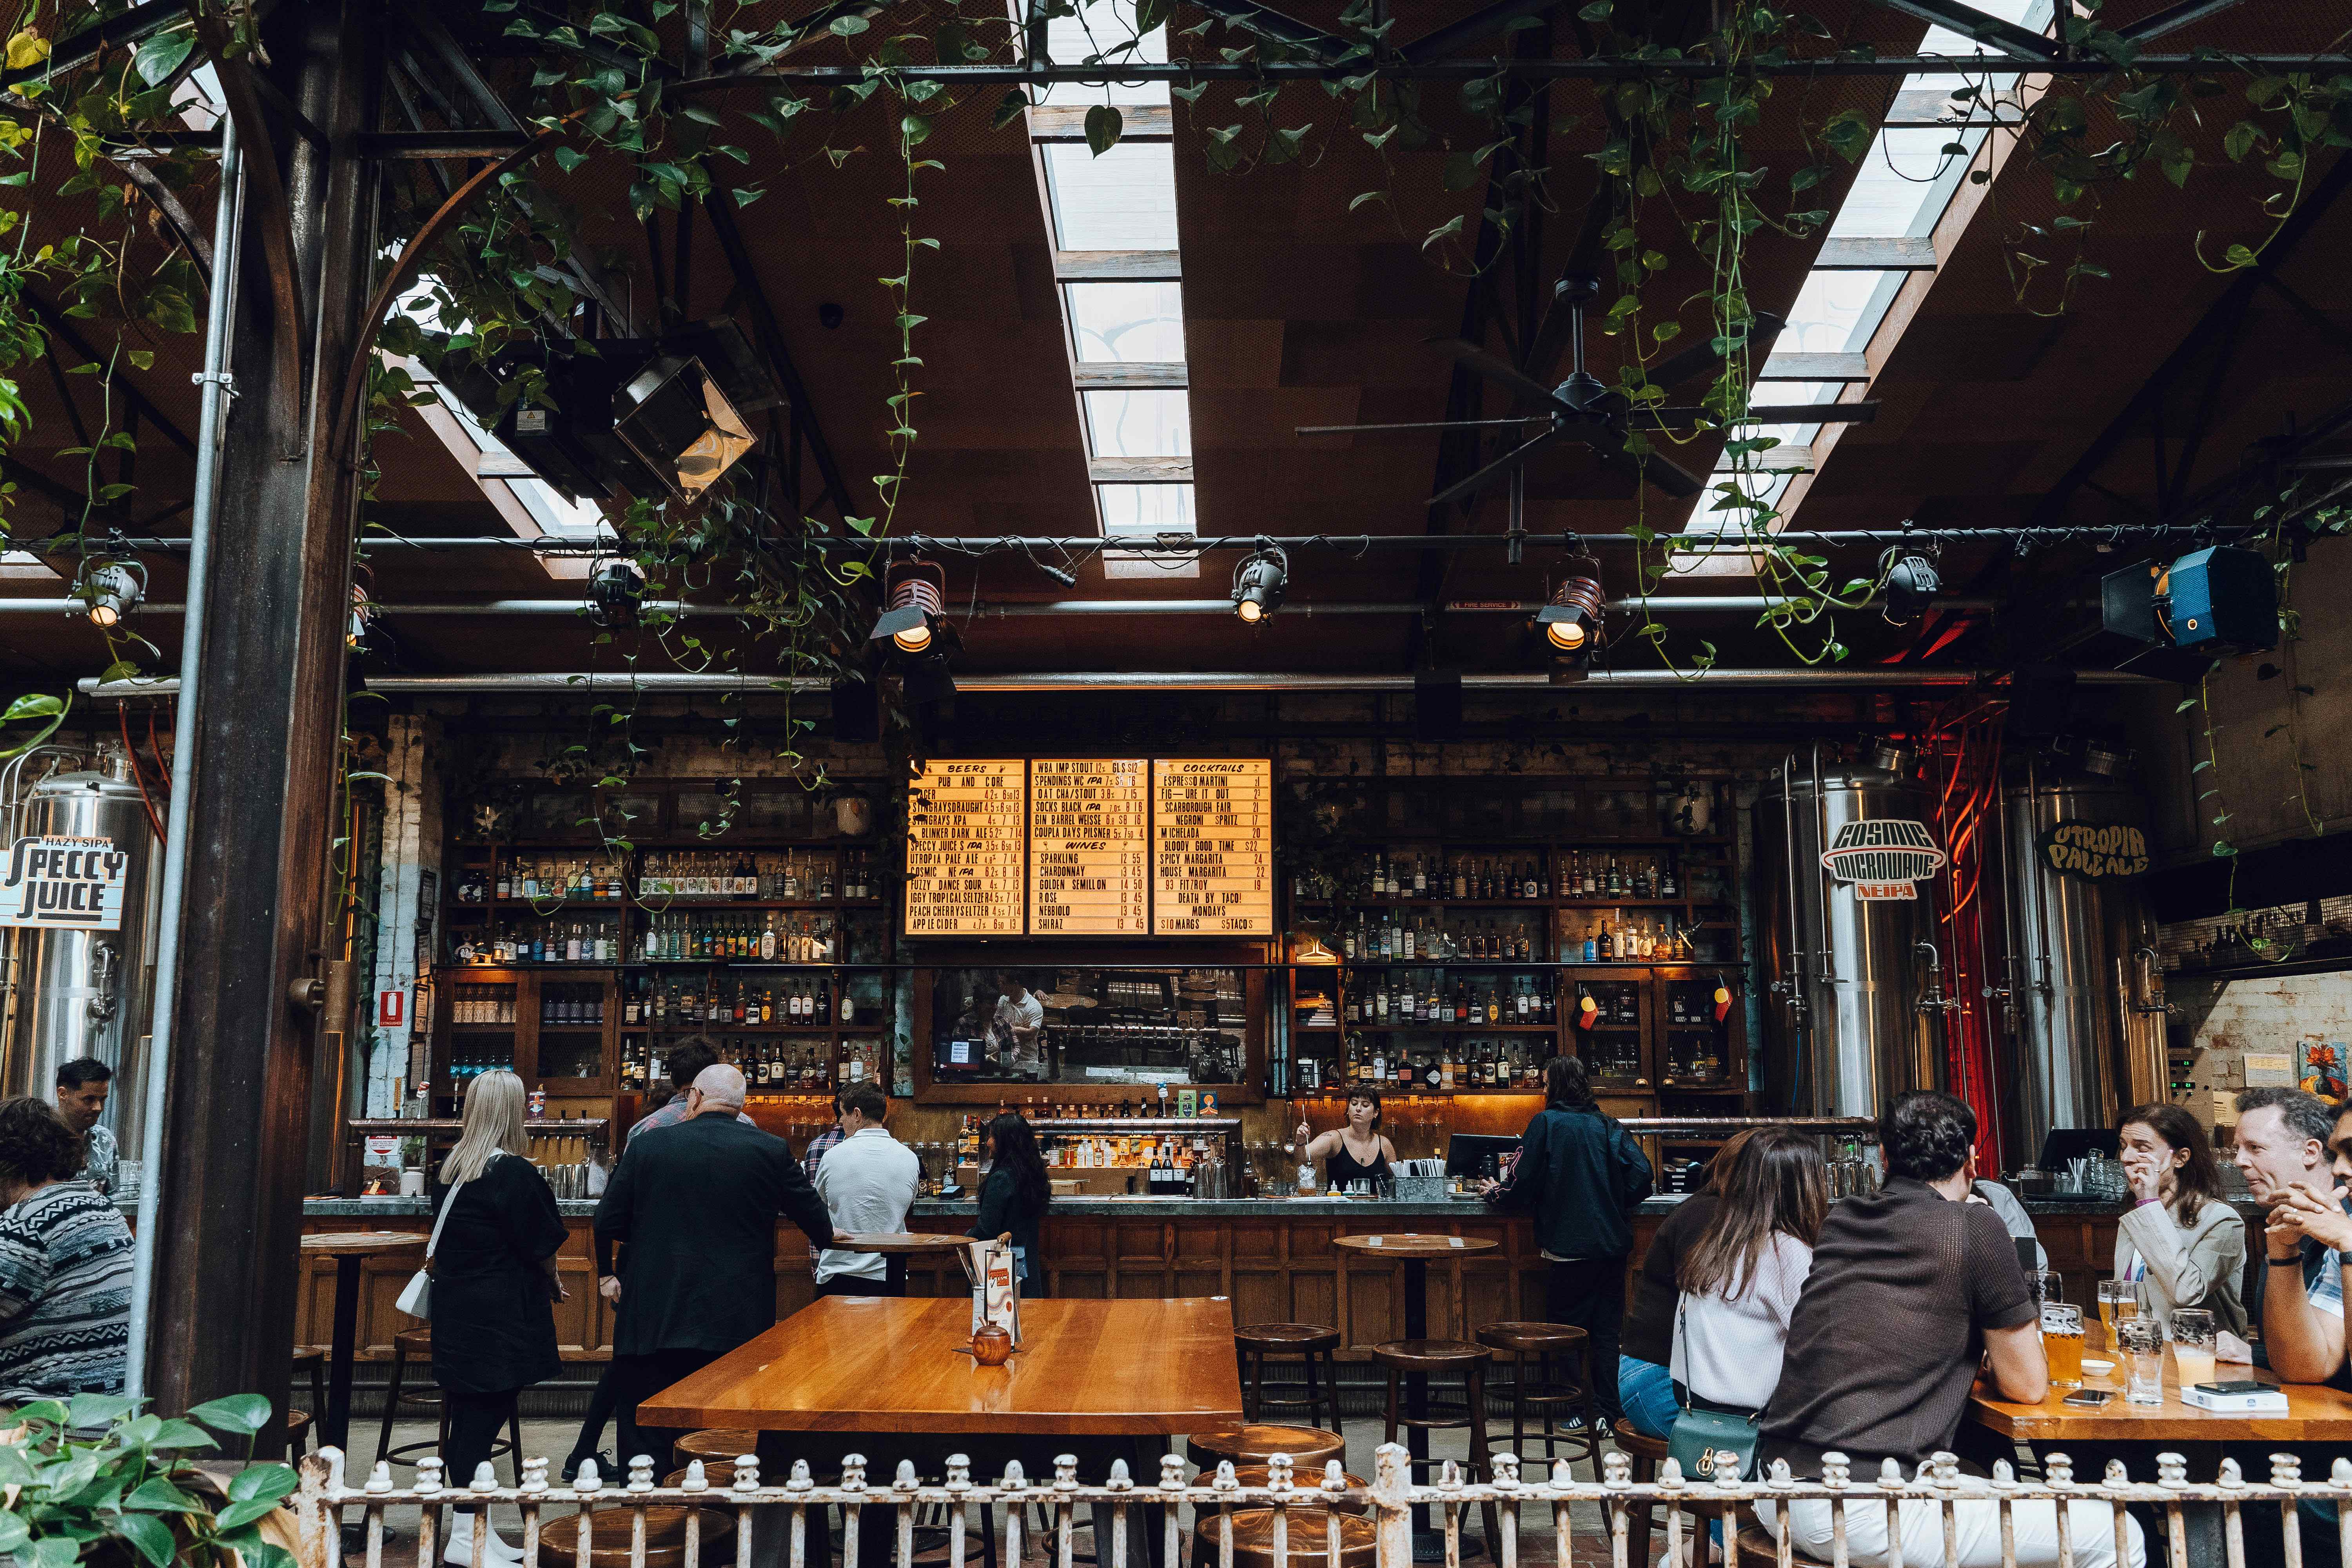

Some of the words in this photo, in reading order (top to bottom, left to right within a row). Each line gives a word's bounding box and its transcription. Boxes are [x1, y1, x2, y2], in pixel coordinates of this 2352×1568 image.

[1038, 763, 1052, 773] WBA
[1056, 763, 1069, 773] IMP
[1072, 763, 1093, 773] STOUT
[938, 777, 950, 787] PUB
[962, 777, 975, 787] AND
[986, 777, 1003, 787] CORE
[1035, 776, 1071, 786] SPENDINGS
[1074, 776, 1083, 786] WC
[1164, 776, 1197, 786] ESPRESSO
[1200, 776, 1227, 786] MARTINI
[1255, 776, 1259, 786] 21
[1014, 789, 1019, 800] 13
[1038, 789, 1052, 799] OAT
[1124, 789, 1126, 799] 7
[1131, 789, 1136, 799] 15
[1202, 789, 1208, 799] IT
[1216, 789, 1229, 799] OUT
[1254, 789, 1260, 799] 23
[1014, 802, 1019, 812] 13
[1036, 802, 1057, 812] SOCKS
[1062, 802, 1082, 812] BLACK
[1126, 802, 1129, 812] 8
[1135, 802, 1142, 812] 16
[1165, 802, 1212, 812] SCARBOROUGH
[1217, 802, 1230, 812] FAIR
[1253, 802, 1258, 812] 21
[954, 815, 966, 825] XPA
[1003, 815, 1005, 825] 7
[1014, 815, 1019, 825] 13
[1035, 815, 1046, 825] GIN
[1052, 815, 1074, 825] BARREL
[1078, 815, 1101, 825] WEISSE
[1135, 815, 1140, 825] 16
[1176, 815, 1203, 825] NEGRONI
[1216, 815, 1238, 825] SPRITZ
[1253, 815, 1258, 825] 17
[922, 828, 948, 838] BLINKER
[952, 828, 969, 838] DARK
[976, 828, 987, 838] ALE
[1010, 828, 1013, 838] 7
[1016, 828, 1022, 838] 14
[1034, 827, 1059, 838] COUPLA
[1063, 827, 1080, 838] DAYS
[1084, 827, 1110, 838] PILSNER
[1253, 828, 1260, 838] 20
[1832, 822, 1935, 849] COSMIC
[46, 838, 78, 847] HAZY
[82, 839, 109, 848] SIPA
[911, 841, 936, 851] SPECCY
[939, 841, 956, 851] JUICE
[1015, 841, 1020, 851] 13
[1165, 841, 1189, 851] BLOODY
[1196, 841, 1212, 851] GOOD
[1219, 841, 1234, 851] TIME
[2055, 826, 2145, 856] UTROPIA
[4, 838, 124, 887] SPECCY
[911, 854, 940, 864] UTROPIA
[946, 854, 960, 864] PALE
[966, 854, 978, 864] ALE
[1004, 854, 1007, 864] 7
[1011, 854, 1016, 864] 14
[1041, 853, 1078, 864] SPARKLING
[1121, 853, 1127, 864] 12
[1133, 853, 1140, 864] 55
[1160, 854, 1180, 864] SPICY
[1185, 854, 1222, 864] MARGARITA
[1255, 854, 1262, 864] 24
[2049, 844, 2103, 876] PALE
[2106, 857, 2149, 875] ALE
[1833, 853, 1934, 879] MICROWAVE
[911, 867, 936, 877] COSMIC
[949, 867, 956, 877] NE
[1003, 867, 1006, 877] 8
[1013, 867, 1019, 877] 16
[1040, 866, 1085, 877] CHARDONNAY
[1122, 866, 1126, 877] 13
[1132, 866, 1140, 877] 45
[1161, 867, 1181, 877] HOUSE
[1189, 867, 1226, 877] MARGARITA
[1257, 867, 1264, 877] 22
[911, 880, 931, 890] FUZZY
[939, 880, 959, 890] DANCE
[965, 880, 982, 890] SOUR
[1004, 880, 1006, 890] 7
[1013, 880, 1018, 890] 13
[1040, 879, 1064, 890] GOLDEN
[1073, 879, 1106, 890] SEMILLON
[1122, 879, 1128, 890] 14
[1134, 879, 1142, 890] 50
[1166, 880, 1173, 890] 93
[1180, 880, 1207, 890] FITZROY
[1255, 880, 1260, 890] 19
[1857, 884, 1914, 897] NEIPA
[16, 882, 105, 918] JUICE
[911, 893, 926, 903] IGGY
[1007, 893, 1010, 903] 7
[1014, 893, 1020, 903] 14
[1040, 893, 1056, 903] ROSE
[1122, 893, 1126, 903] 13
[1134, 893, 1142, 903] 45
[1179, 893, 1198, 903] DEATH
[1206, 893, 1214, 903] BY
[1222, 893, 1241, 903] TACO!
[910, 906, 930, 916] PEACH
[1008, 906, 1011, 916] 7
[1014, 906, 1020, 916] 14
[1040, 906, 1070, 916] NEBBIOLO
[1122, 906, 1127, 916] 13
[1133, 906, 1141, 916] 45
[1192, 906, 1225, 916] MONDAYS
[937, 919, 957, 929] CIDER
[1010, 919, 1015, 929] 13
[1039, 919, 1062, 929] SHIRAZ
[1118, 919, 1123, 929] 13
[1136, 919, 1143, 929] 45
